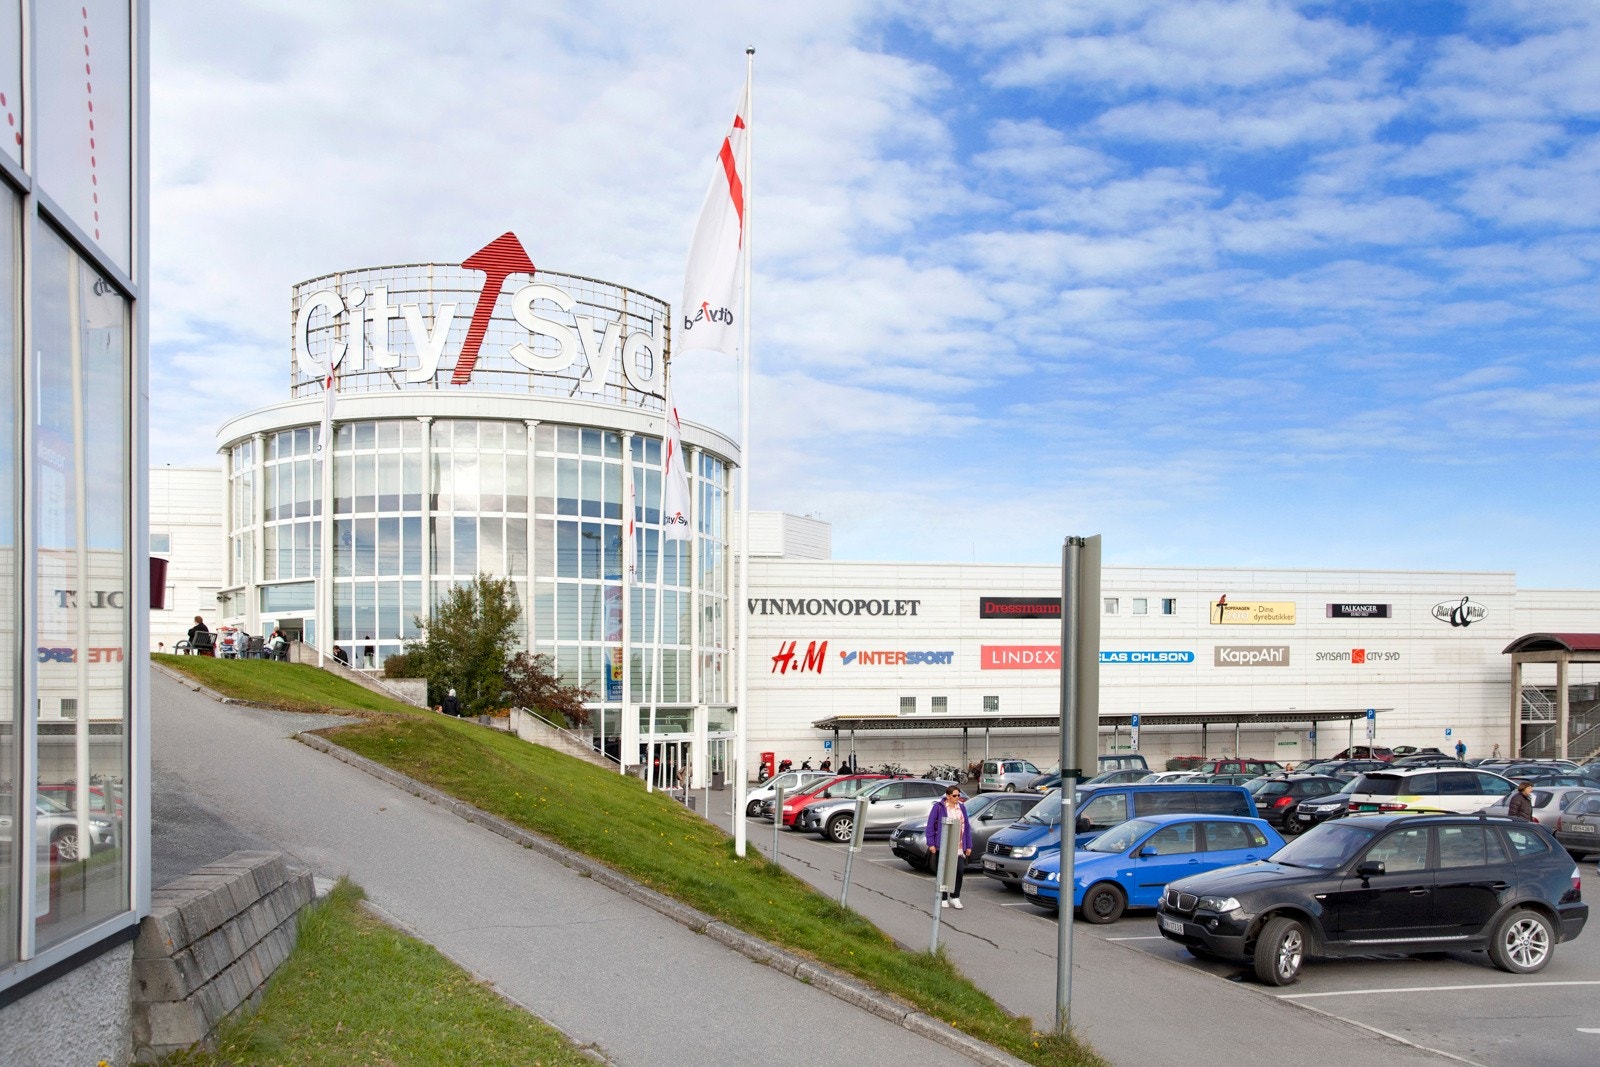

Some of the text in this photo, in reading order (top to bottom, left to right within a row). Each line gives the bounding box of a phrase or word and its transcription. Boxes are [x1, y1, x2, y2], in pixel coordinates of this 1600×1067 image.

[296, 283, 666, 395] City Syd
[747, 598, 921, 616] VINMONOPOLET
[985, 602, 1061, 614] Dressmann
[1258, 605, 1274, 613] Dine
[1253, 613, 1295, 622] dyrebutikker
[771, 640, 828, 675] H&M
[858, 651, 955, 666] INTERSPORT
[992, 650, 1058, 664] LINDEX
[1131, 652, 1189, 662] OHLSON
[1219, 648, 1285, 665] KappAhl
[1315, 651, 1401, 661] SYNSAM CITY SYD
